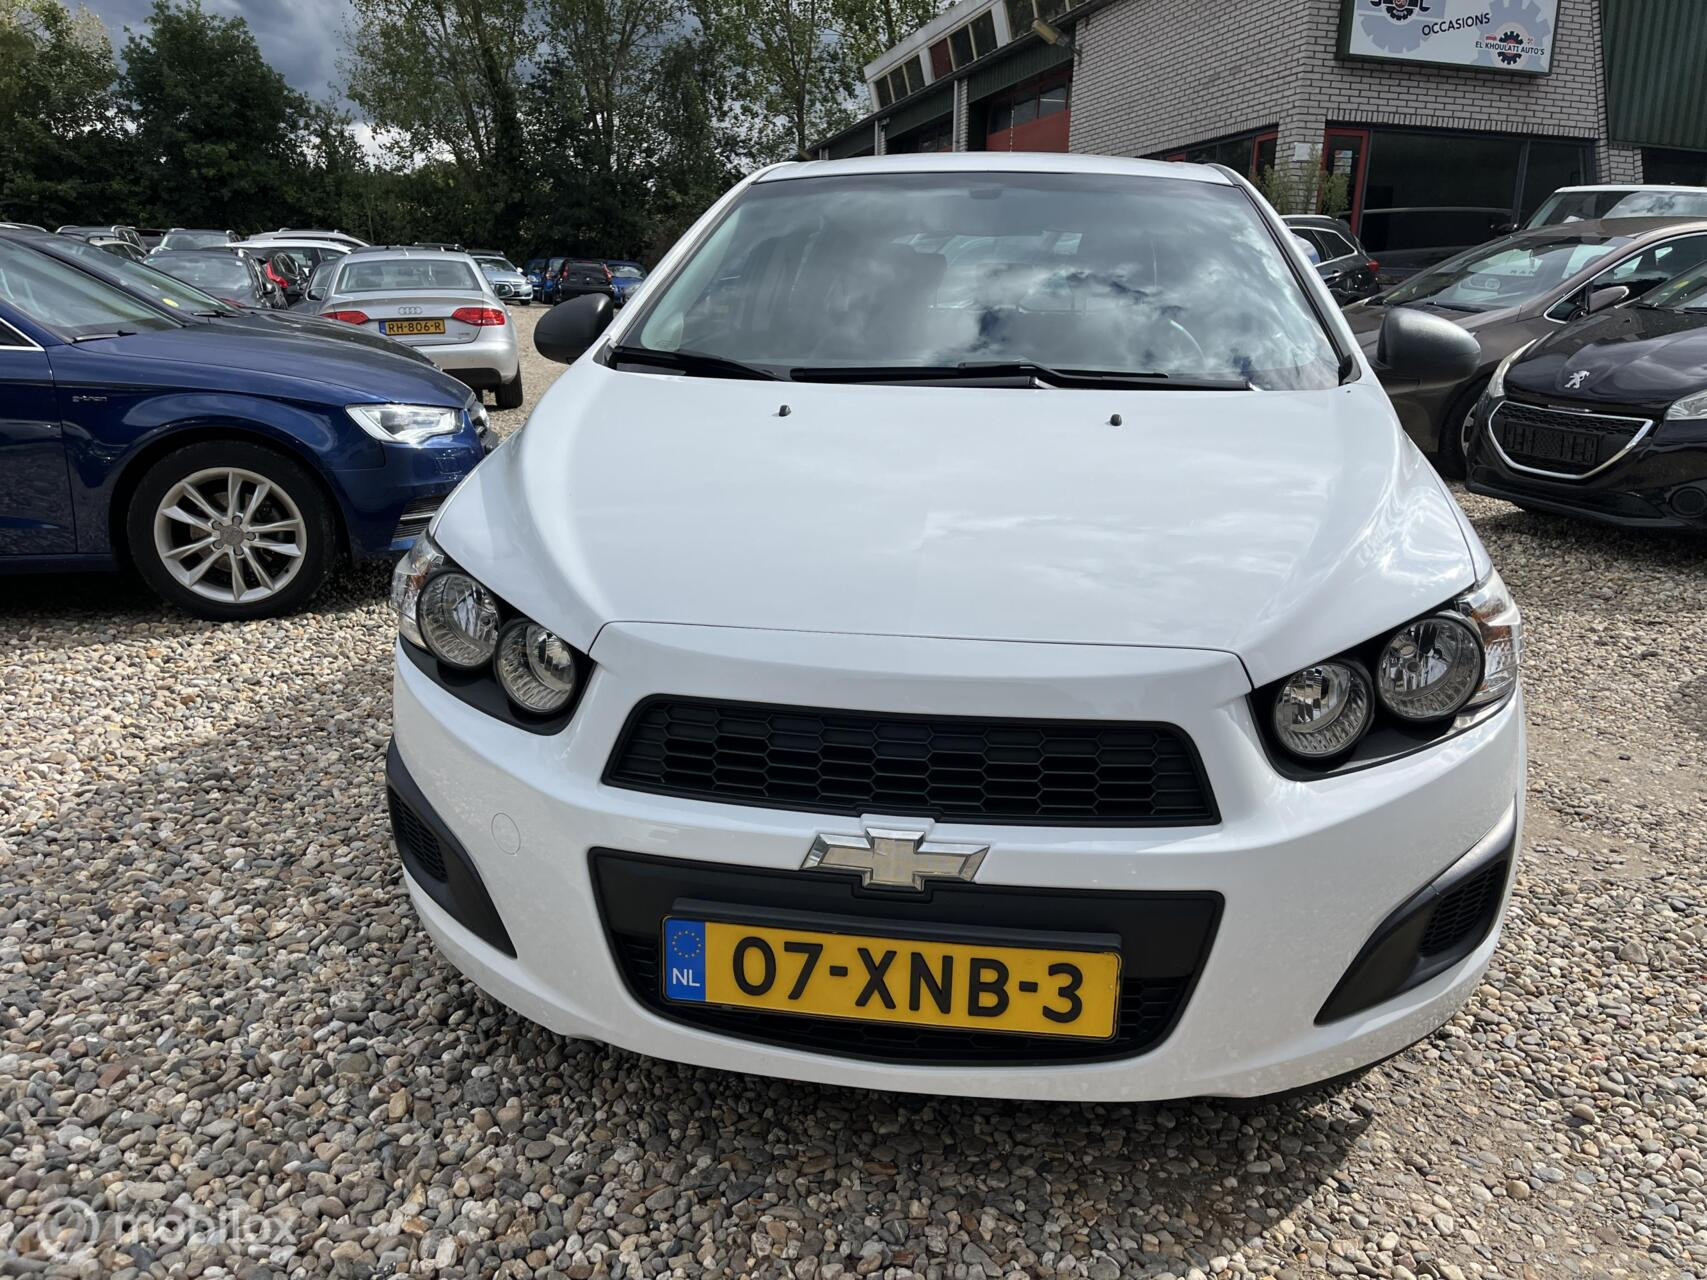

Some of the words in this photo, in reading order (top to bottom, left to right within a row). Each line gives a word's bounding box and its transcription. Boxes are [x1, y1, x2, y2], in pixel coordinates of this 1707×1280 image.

[1421, 12, 1491, 36] OCCASIONS
[1475, 40, 1483, 49] EL
[1520, 46, 1545, 56] AUTO'S
[388, 321, 442, 334] RH-806-R
[672, 967, 701, 987] NL
[732, 935, 1083, 1024] 07-XNB-3
